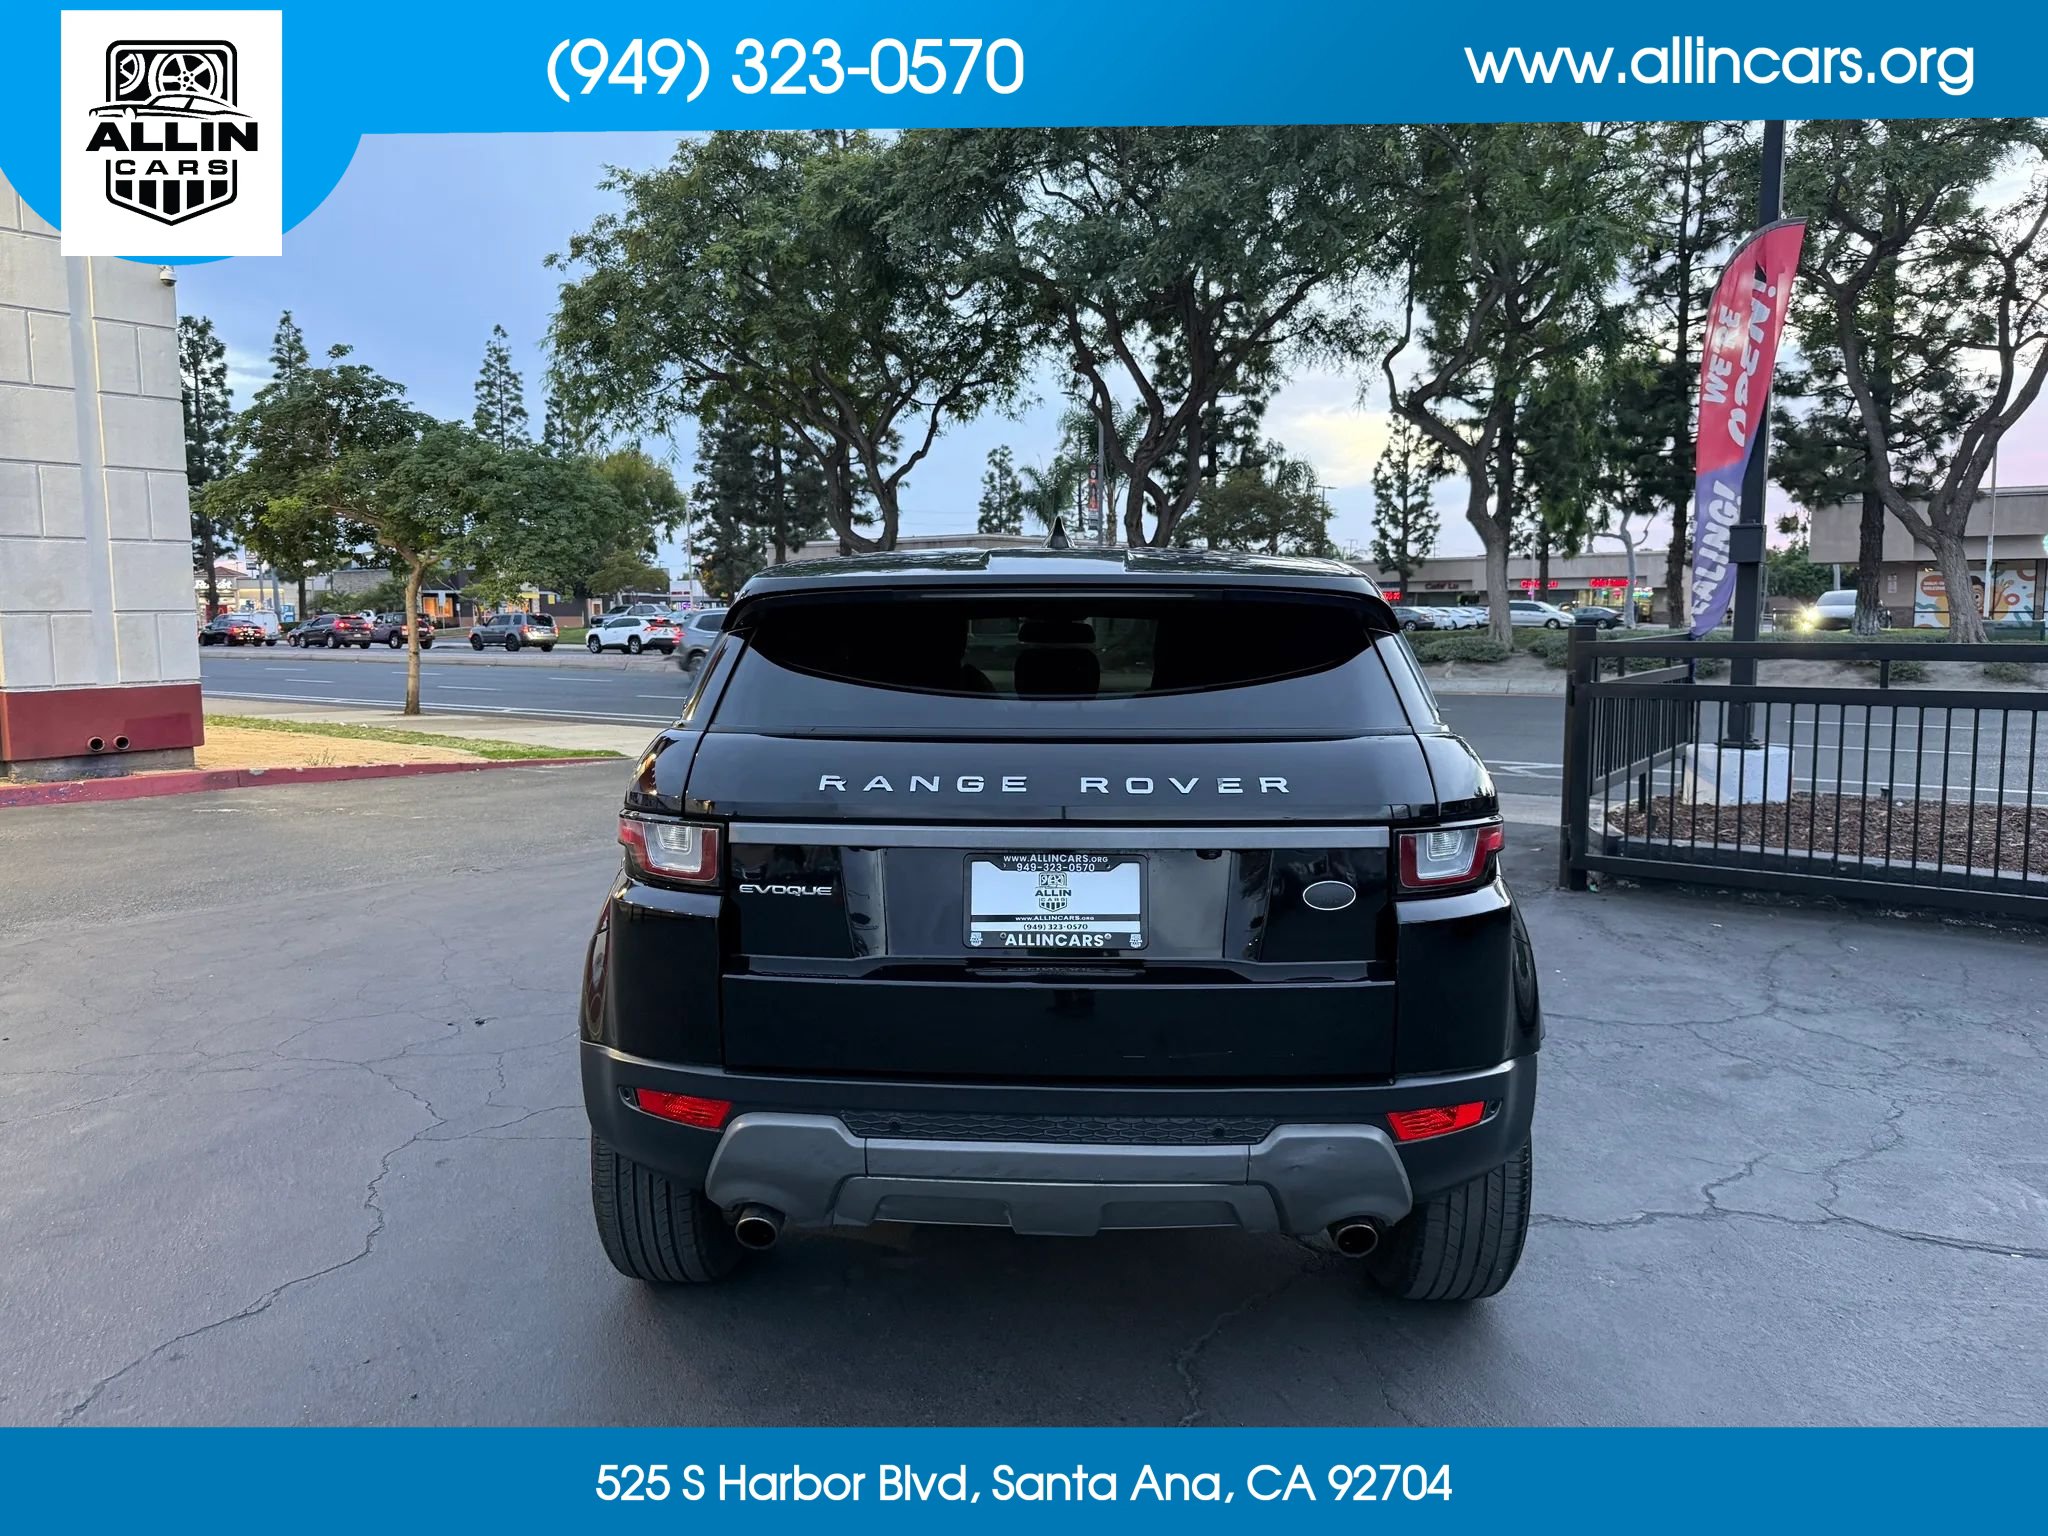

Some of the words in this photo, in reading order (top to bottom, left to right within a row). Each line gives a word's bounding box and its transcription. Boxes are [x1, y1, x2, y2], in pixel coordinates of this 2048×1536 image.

[1702, 304, 1742, 404] WE'RE
[818, 774, 1028, 793] RANGE
[1080, 775, 1290, 794] ROVER
[1016, 863, 1095, 872] 949-323-0570
[738, 883, 833, 897] EVOQUE
[1034, 889, 1072, 897] ALLIN
[1023, 923, 1047, 931] (949)
[1004, 933, 1105, 948] ALLINCARS
